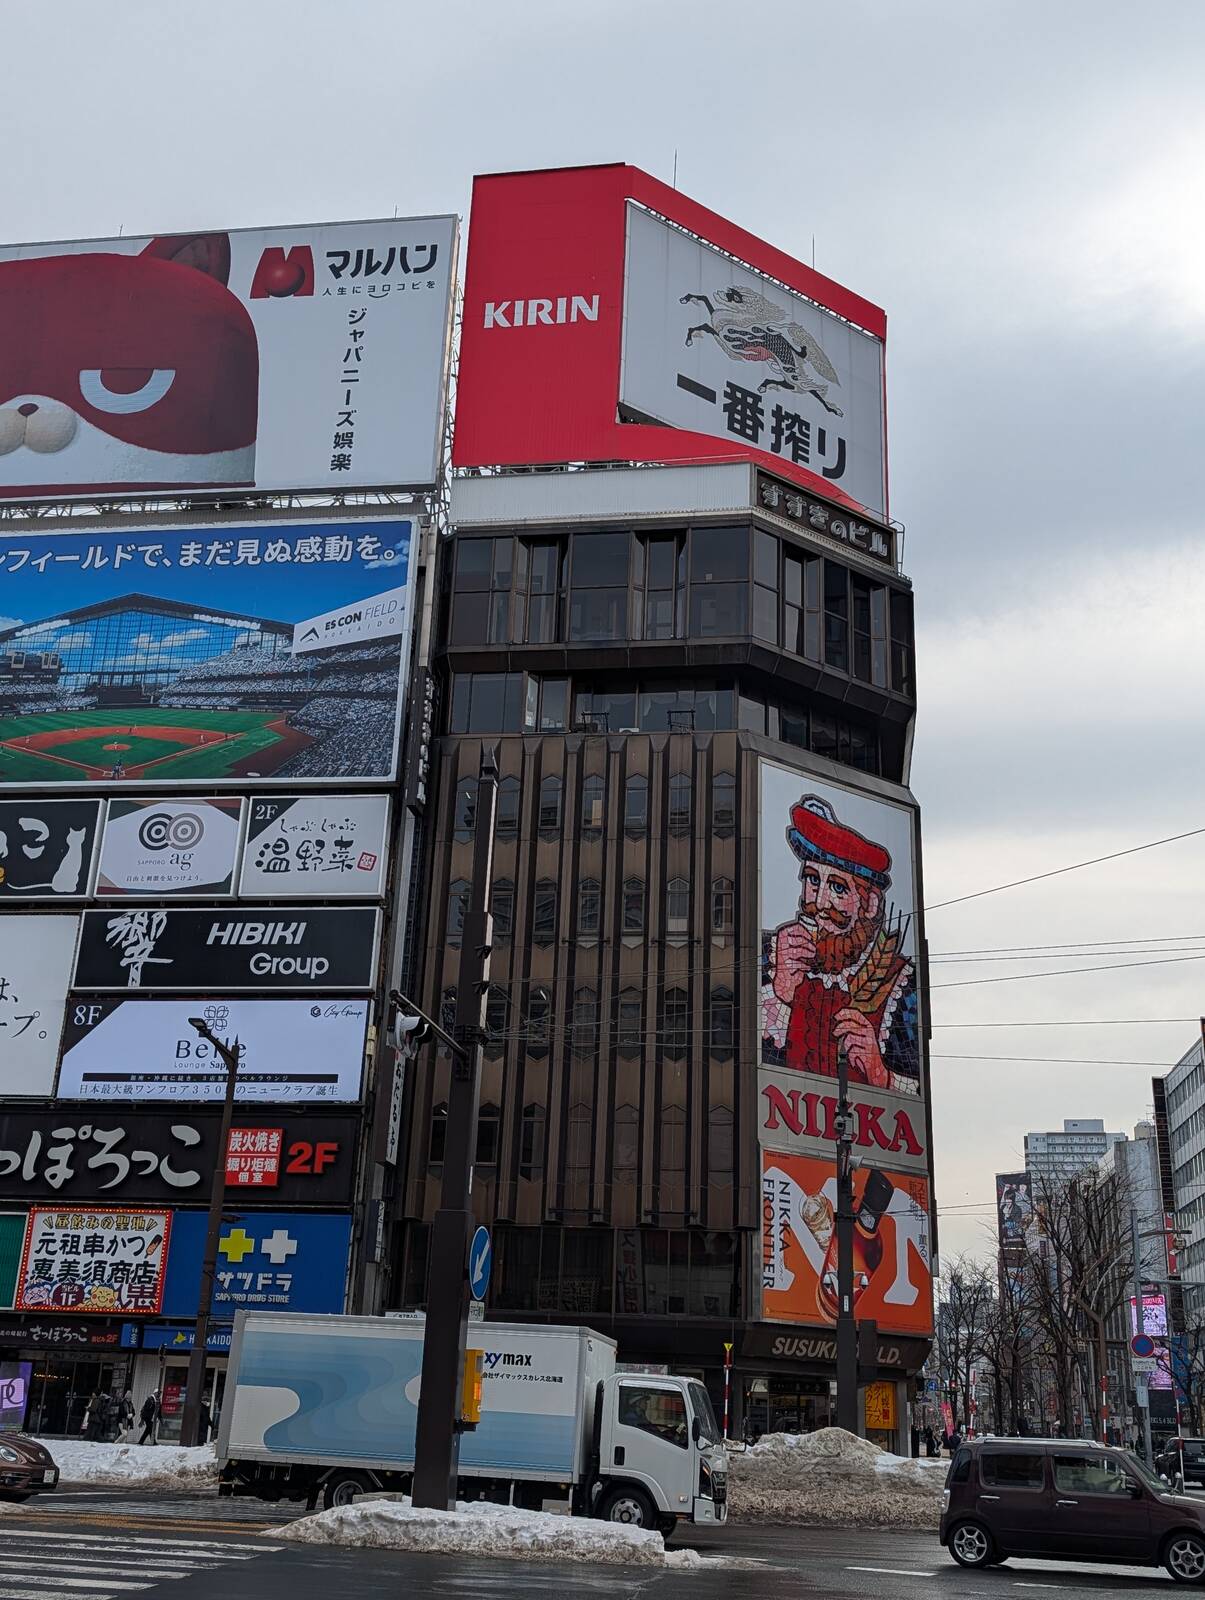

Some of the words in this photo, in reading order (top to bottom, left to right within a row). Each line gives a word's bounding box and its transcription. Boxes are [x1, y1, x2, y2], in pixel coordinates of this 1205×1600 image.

[326, 244, 438, 279] マルハン
[322, 281, 436, 297] 人生にヨロコビを
[483, 295, 600, 328] KIRIN
[330, 307, 368, 472] ジャパニーズ娯楽
[676, 372, 847, 480] 一番搾り
[760, 482, 888, 557] すすきのビル
[0, 534, 398, 573] フィールドで、まだ見ぬ感動を。
[364, 600, 398, 620] FIELD
[255, 804, 278, 820] 2F
[169, 852, 194, 871] ag
[255, 836, 355, 873] 温野菜
[206, 922, 307, 945] HIBIKI
[250, 952, 329, 979] Group
[73, 1004, 102, 1026] 8F
[229, 1131, 281, 1152] 炭火焼き
[286, 1142, 339, 1174] 2F
[238, 1172, 264, 1183] 個室
[54, 1214, 146, 1231] 昼飲みの聖地
[779, 1181, 791, 1252] NIKKA
[34, 1232, 146, 1257] 元祖串かつ
[763, 1179, 775, 1289] FRONTIER
[29, 1258, 157, 1284] 恵美須商店
[216, 1271, 293, 1292] サツドラ
